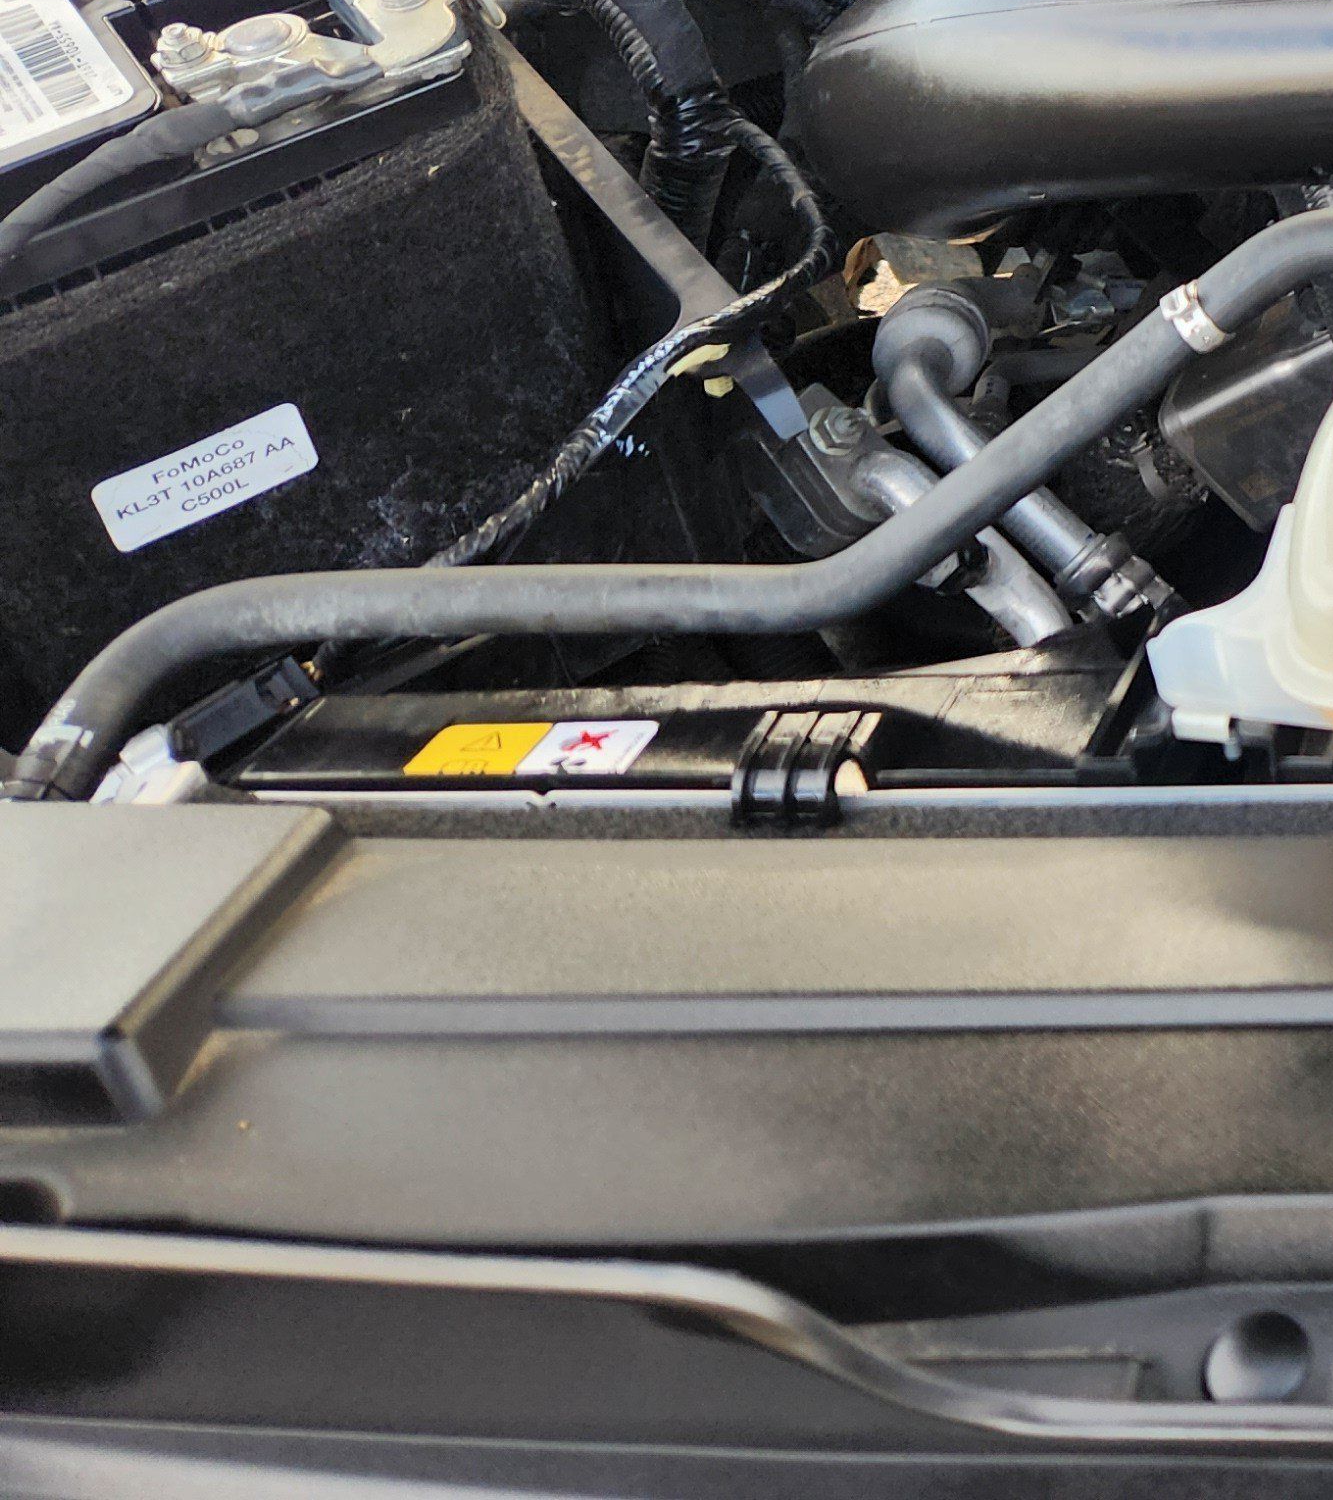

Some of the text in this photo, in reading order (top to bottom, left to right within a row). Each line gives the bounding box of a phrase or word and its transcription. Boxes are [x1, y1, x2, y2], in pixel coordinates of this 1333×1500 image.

[116, 436, 296, 520] KL3T 10A687 AA
[152, 439, 245, 484] FoMoCo
[181, 478, 250, 512] C500L
